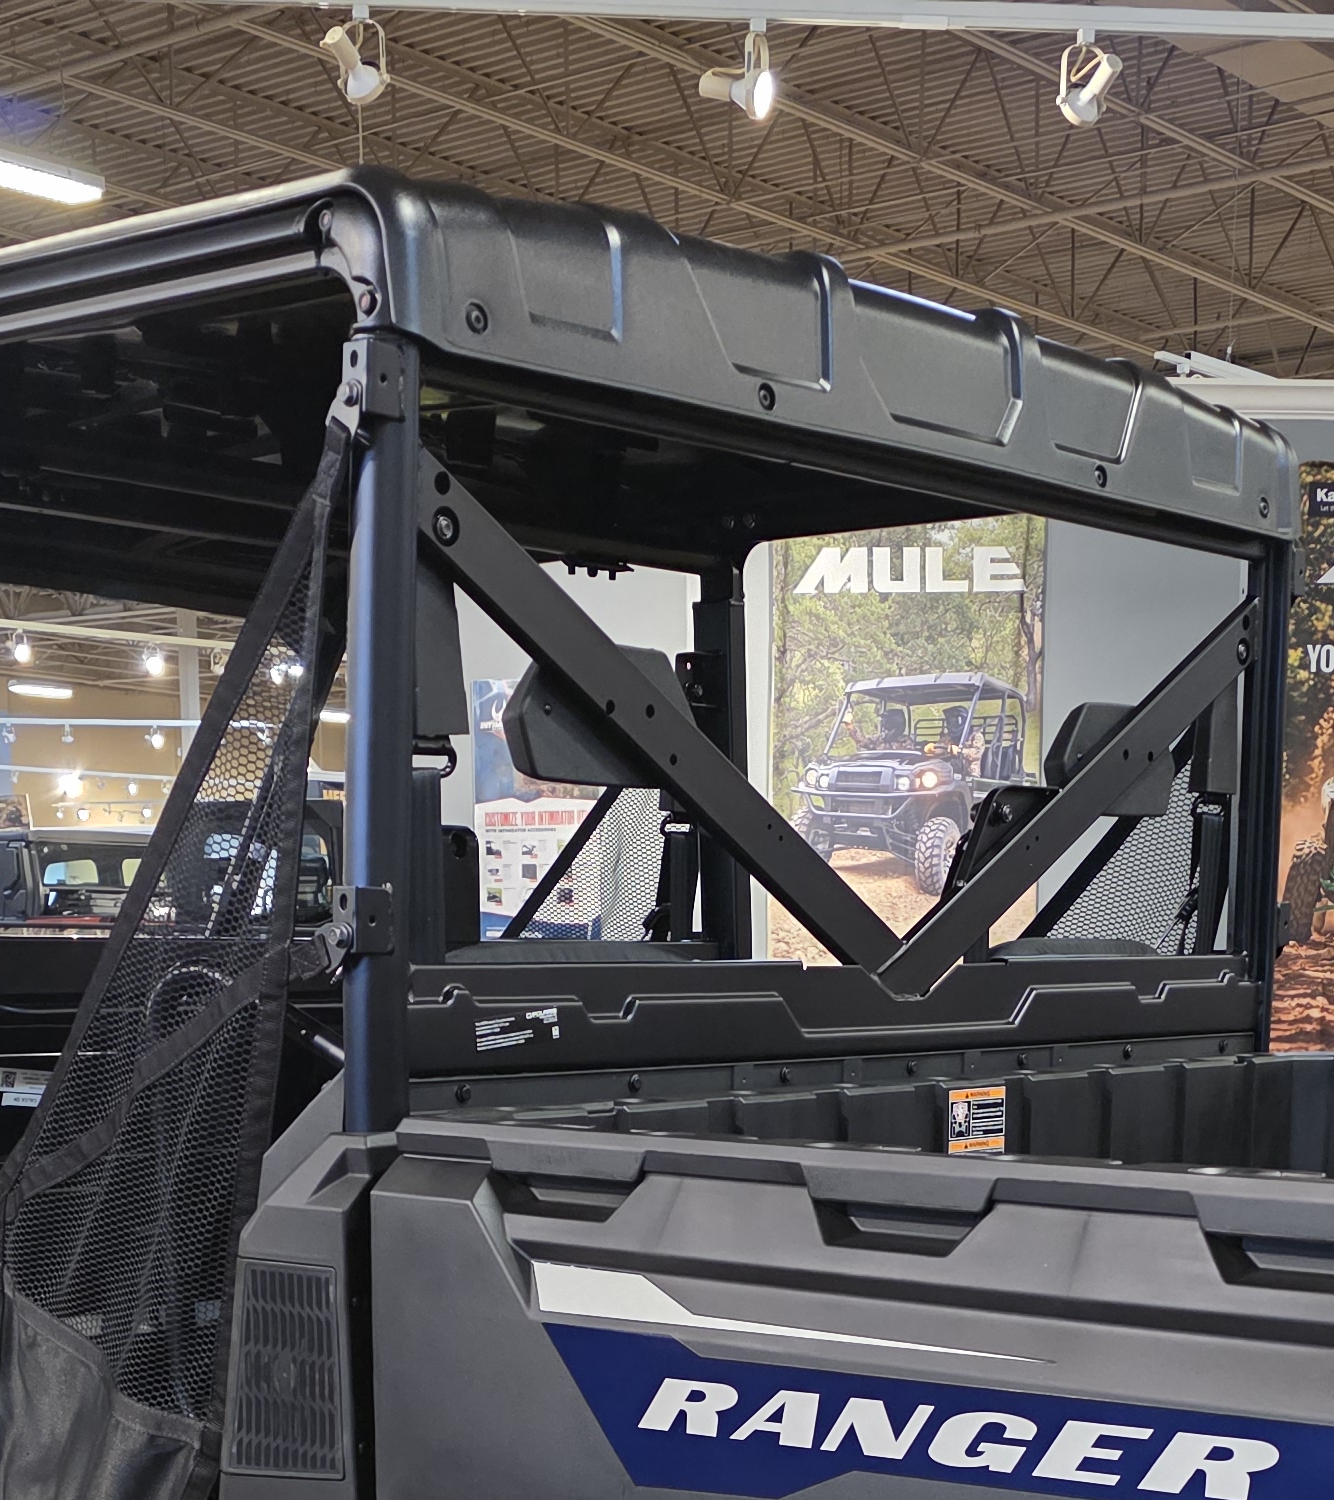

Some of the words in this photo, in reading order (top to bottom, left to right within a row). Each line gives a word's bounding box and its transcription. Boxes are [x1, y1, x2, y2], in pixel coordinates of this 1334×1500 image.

[793, 546, 1028, 594] MULE
[485, 812, 518, 827] CUSTOMIZE
[521, 811, 536, 826] YOUR
